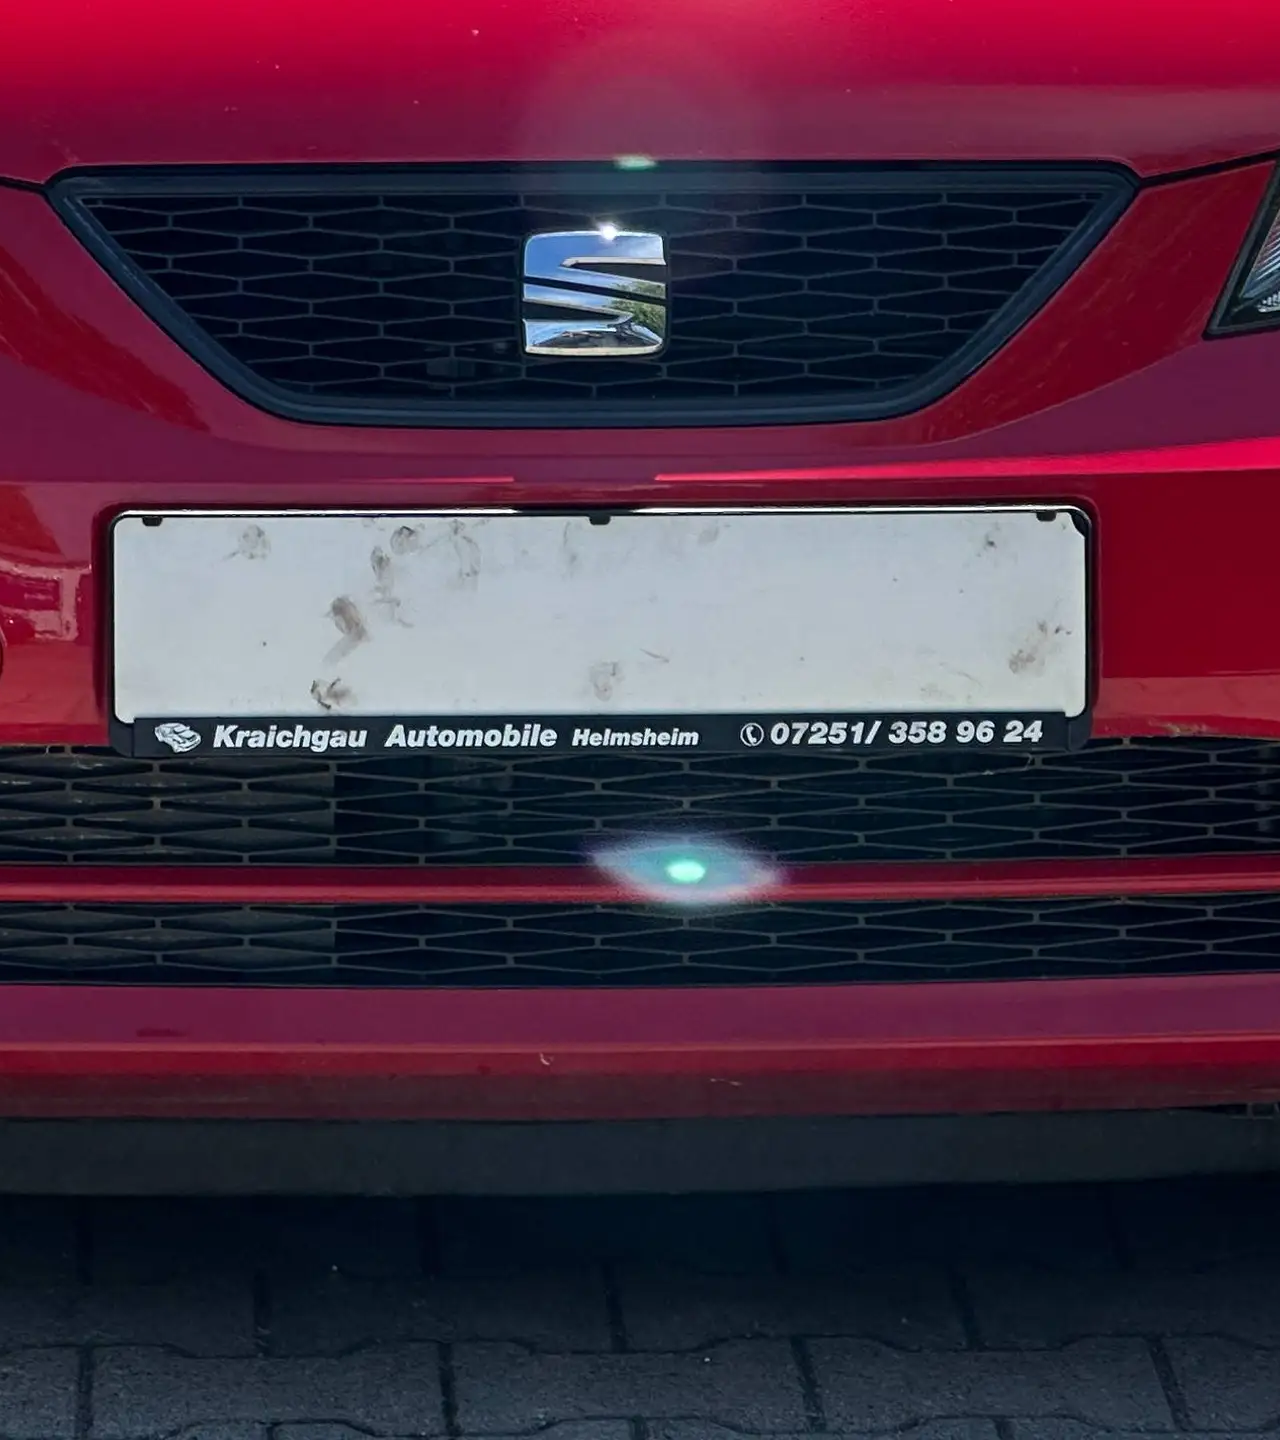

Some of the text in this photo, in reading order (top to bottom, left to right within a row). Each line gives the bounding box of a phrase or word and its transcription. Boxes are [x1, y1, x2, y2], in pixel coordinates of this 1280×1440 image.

[213, 723, 700, 753] Kraichgau Automobile Helmsheim
[770, 719, 1044, 746] 07251/ 358 96 24
